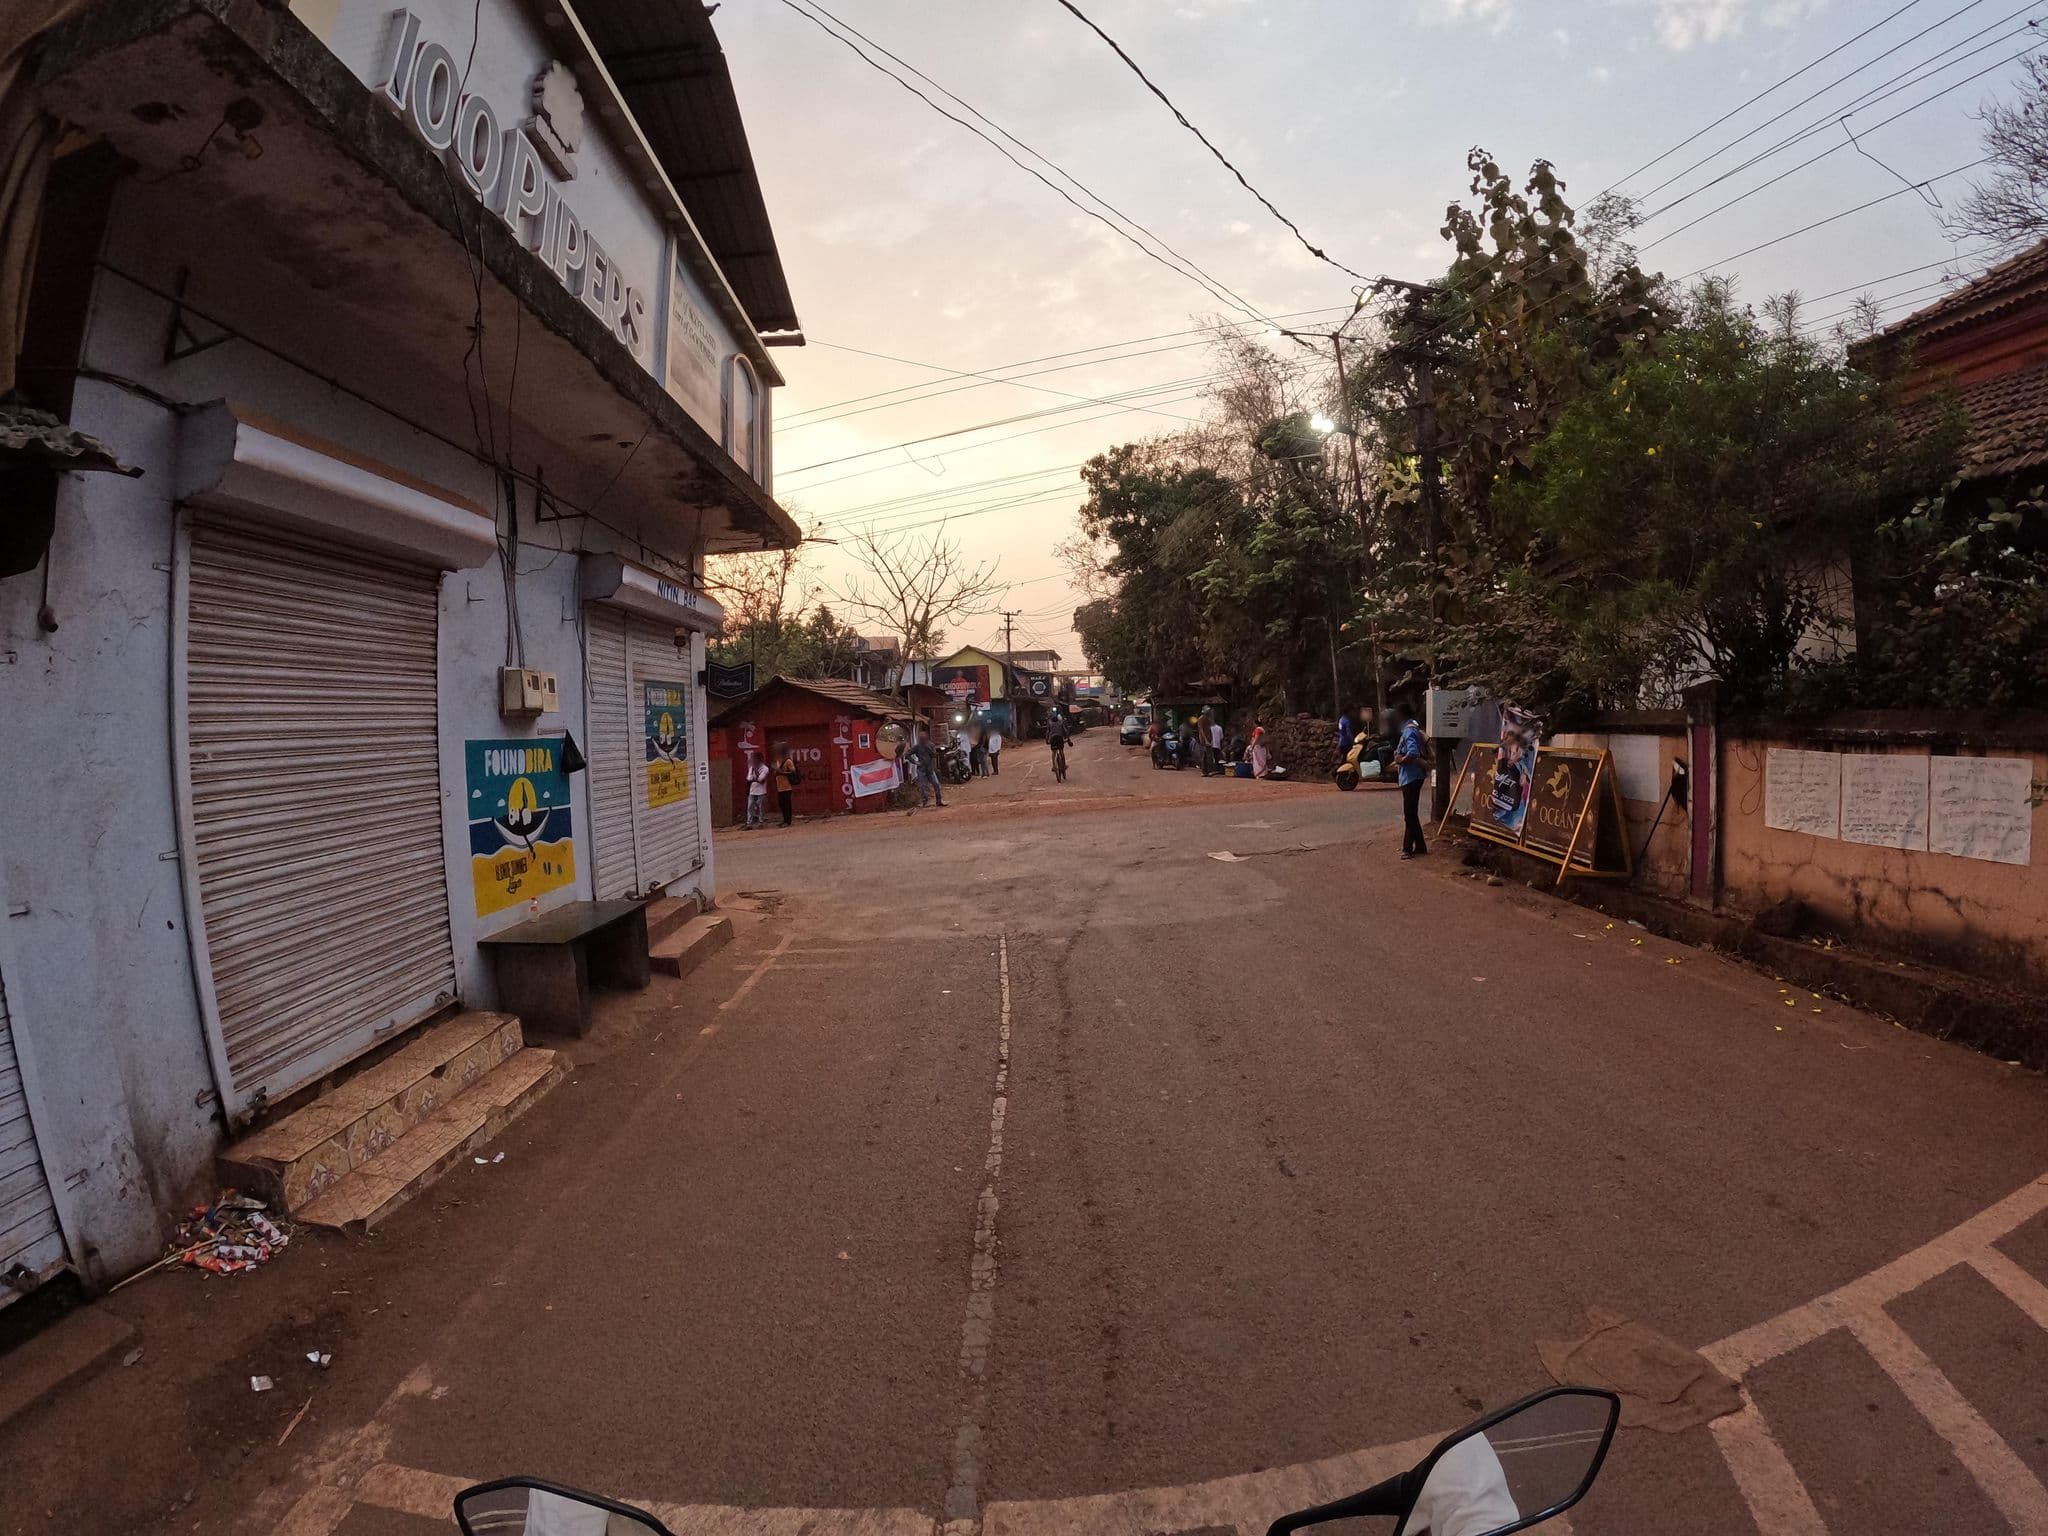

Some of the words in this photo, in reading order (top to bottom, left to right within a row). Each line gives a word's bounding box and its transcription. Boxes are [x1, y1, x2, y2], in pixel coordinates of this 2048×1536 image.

[376, 8, 501, 199] 100
[501, 130, 648, 362] PIPERS
[657, 580, 679, 602] NITIN
[683, 590, 697, 609] BAR
